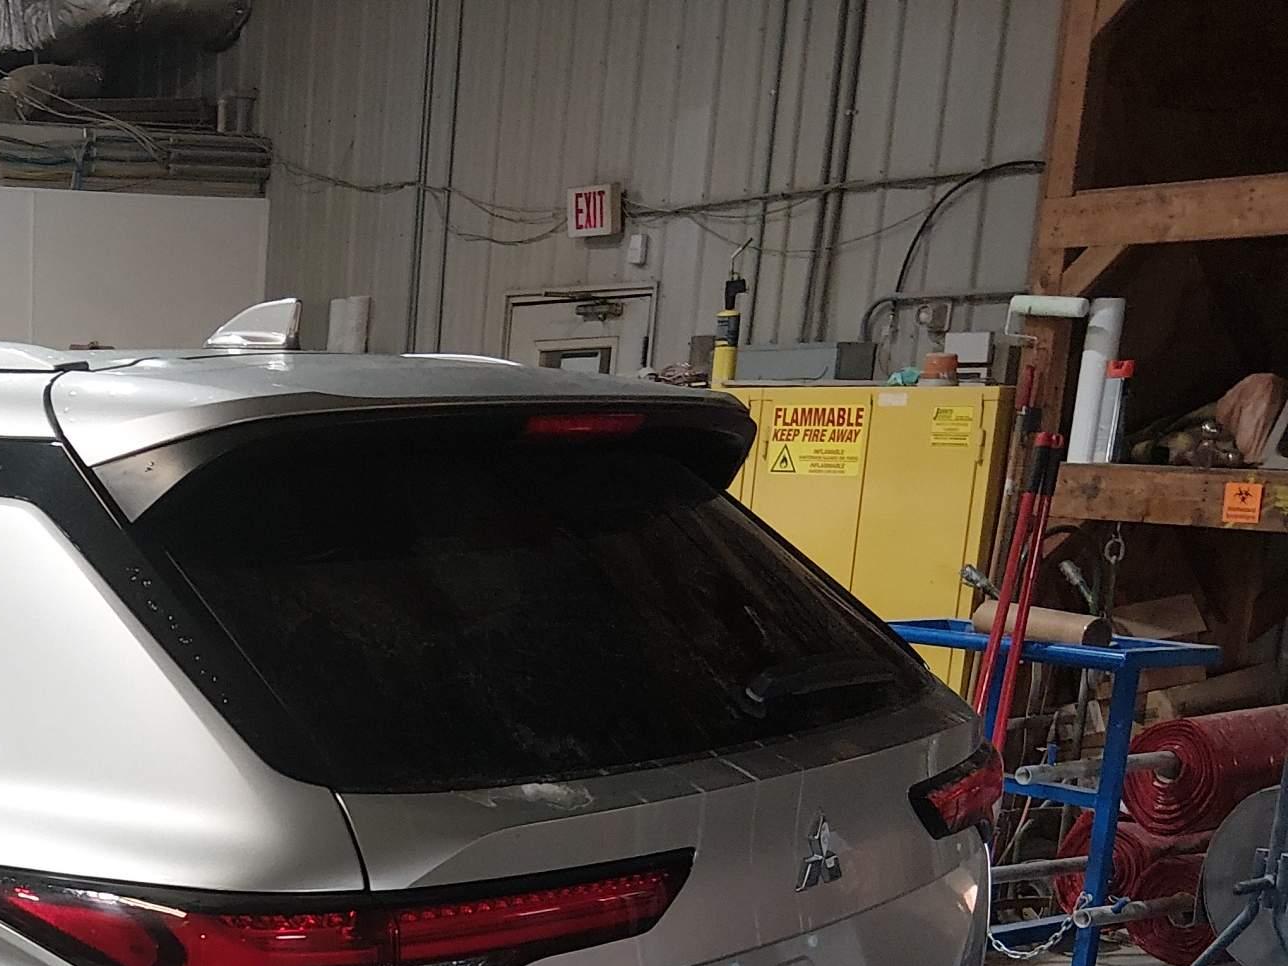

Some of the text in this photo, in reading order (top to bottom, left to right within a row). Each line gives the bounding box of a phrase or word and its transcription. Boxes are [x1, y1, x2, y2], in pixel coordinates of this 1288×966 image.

[575, 190, 605, 230] EXIT
[774, 407, 864, 427] FLAMMABLE
[772, 428, 861, 443] KEEP FIRE AWAY
